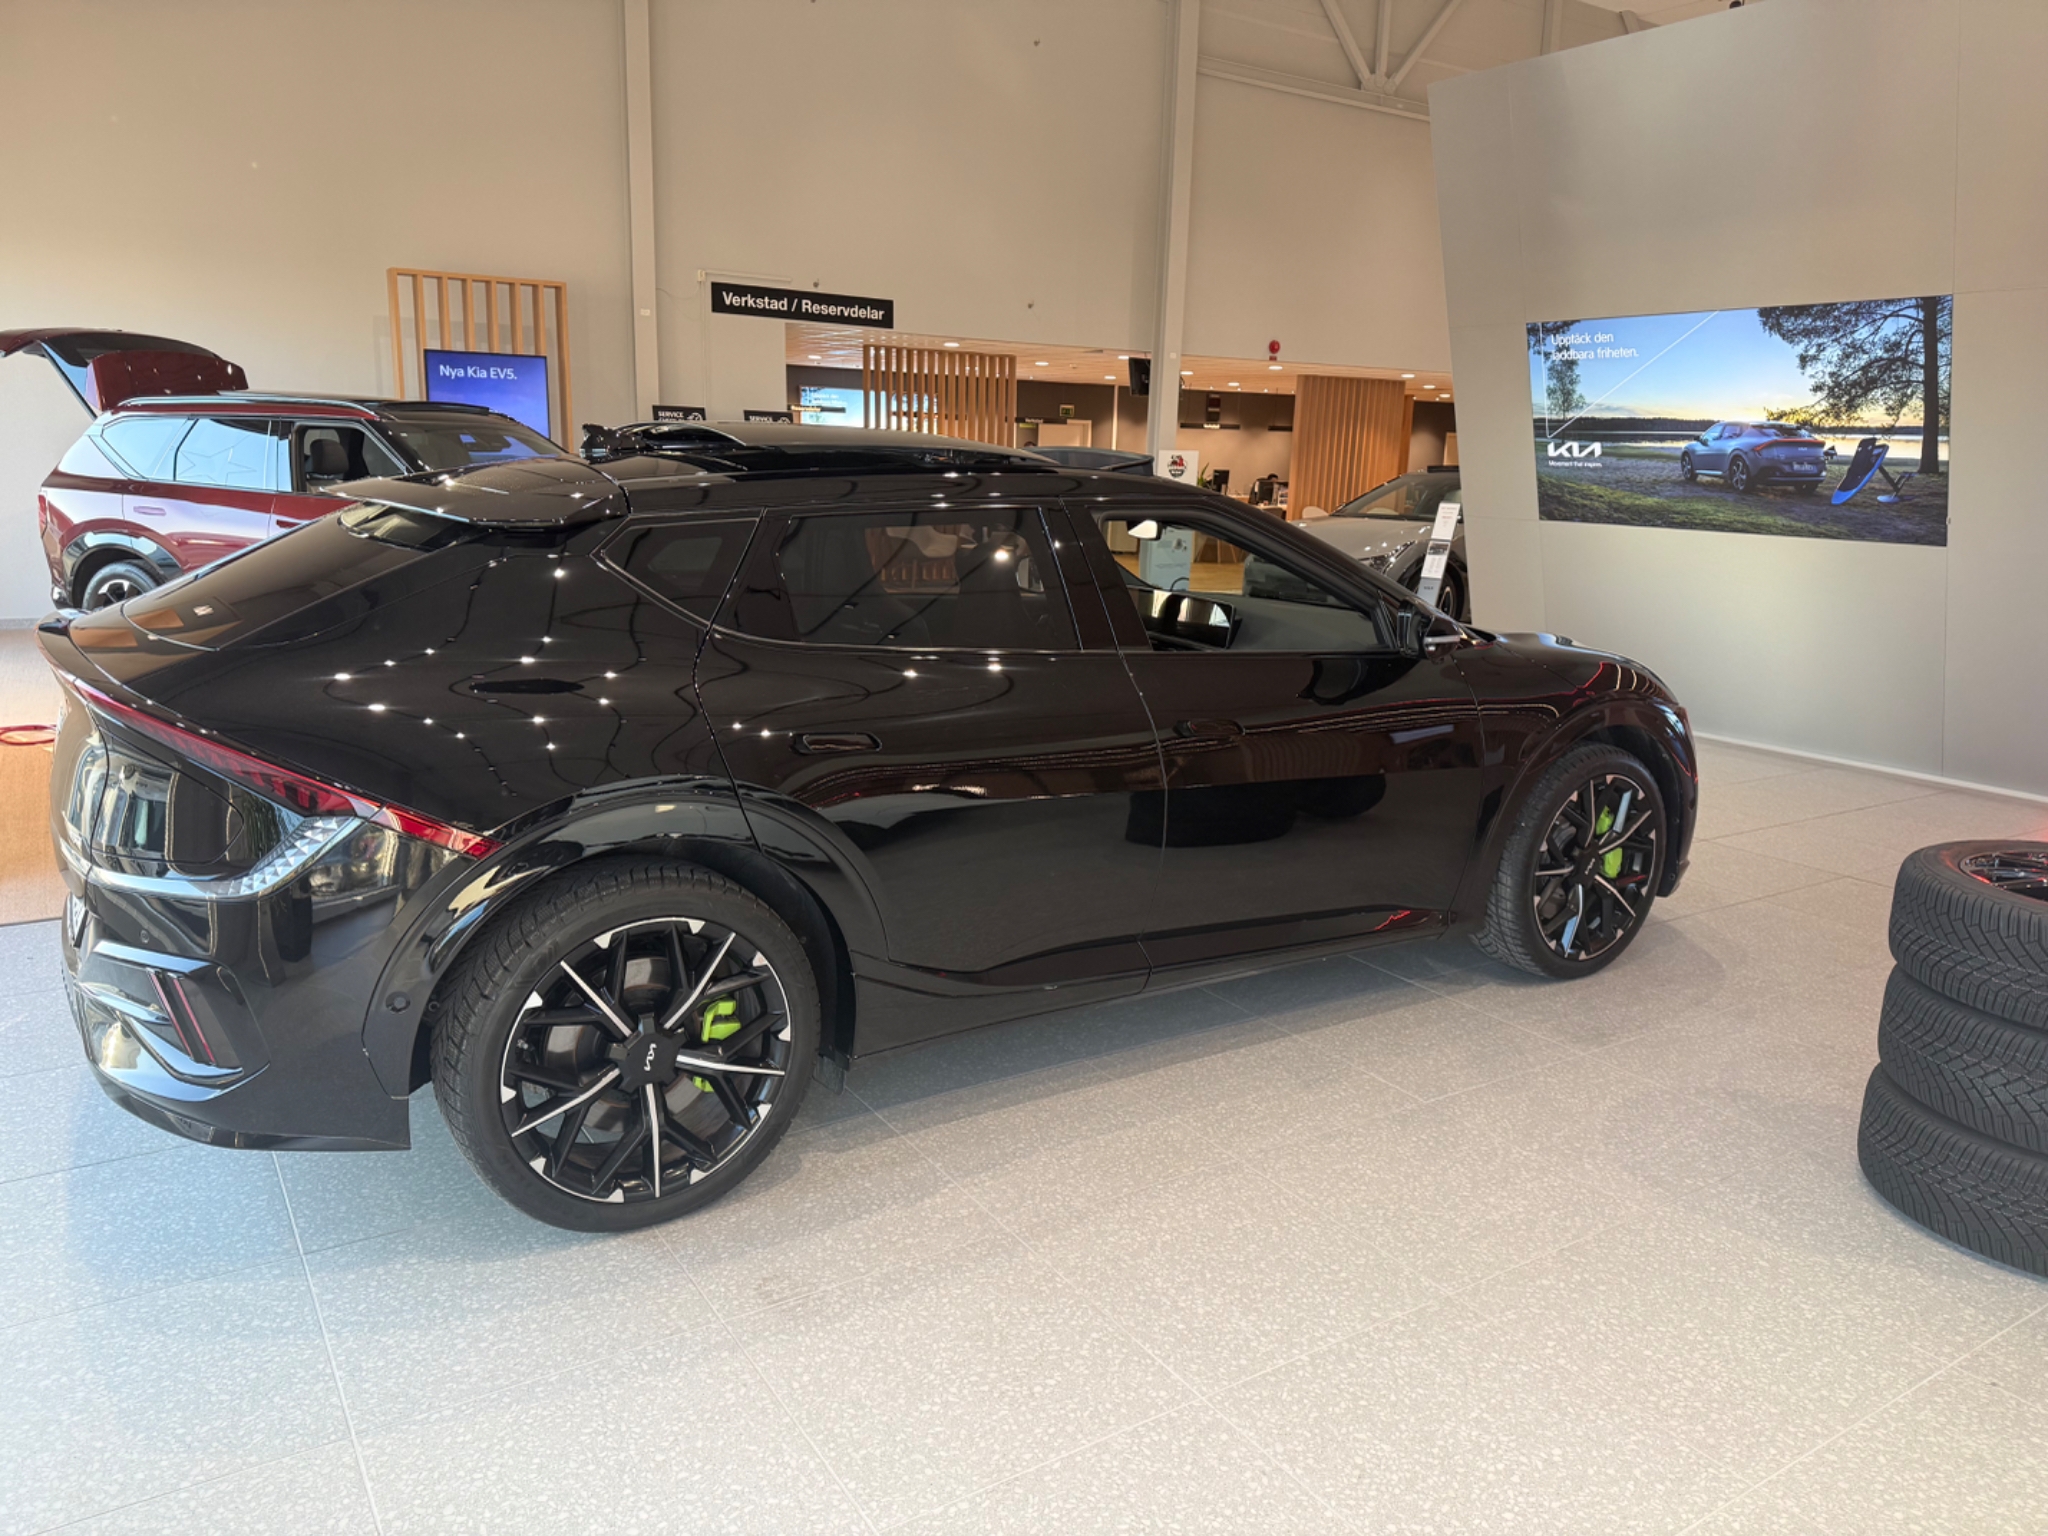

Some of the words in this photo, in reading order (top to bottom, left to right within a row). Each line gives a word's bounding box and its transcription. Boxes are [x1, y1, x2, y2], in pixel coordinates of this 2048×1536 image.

[722, 291, 788, 311] Verkstad
[791, 298, 797, 312] /
[801, 299, 885, 321] Reservdelar
[1551, 332, 1591, 348] Upptäck
[1594, 331, 1614, 344] den
[1552, 348, 1594, 361] laddbara
[439, 364, 464, 380] Nya
[467, 365, 487, 379] Kia
[490, 367, 517, 380] EV5.
[658, 410, 684, 419] SERVICE
[1547, 441, 1603, 459] KIA
